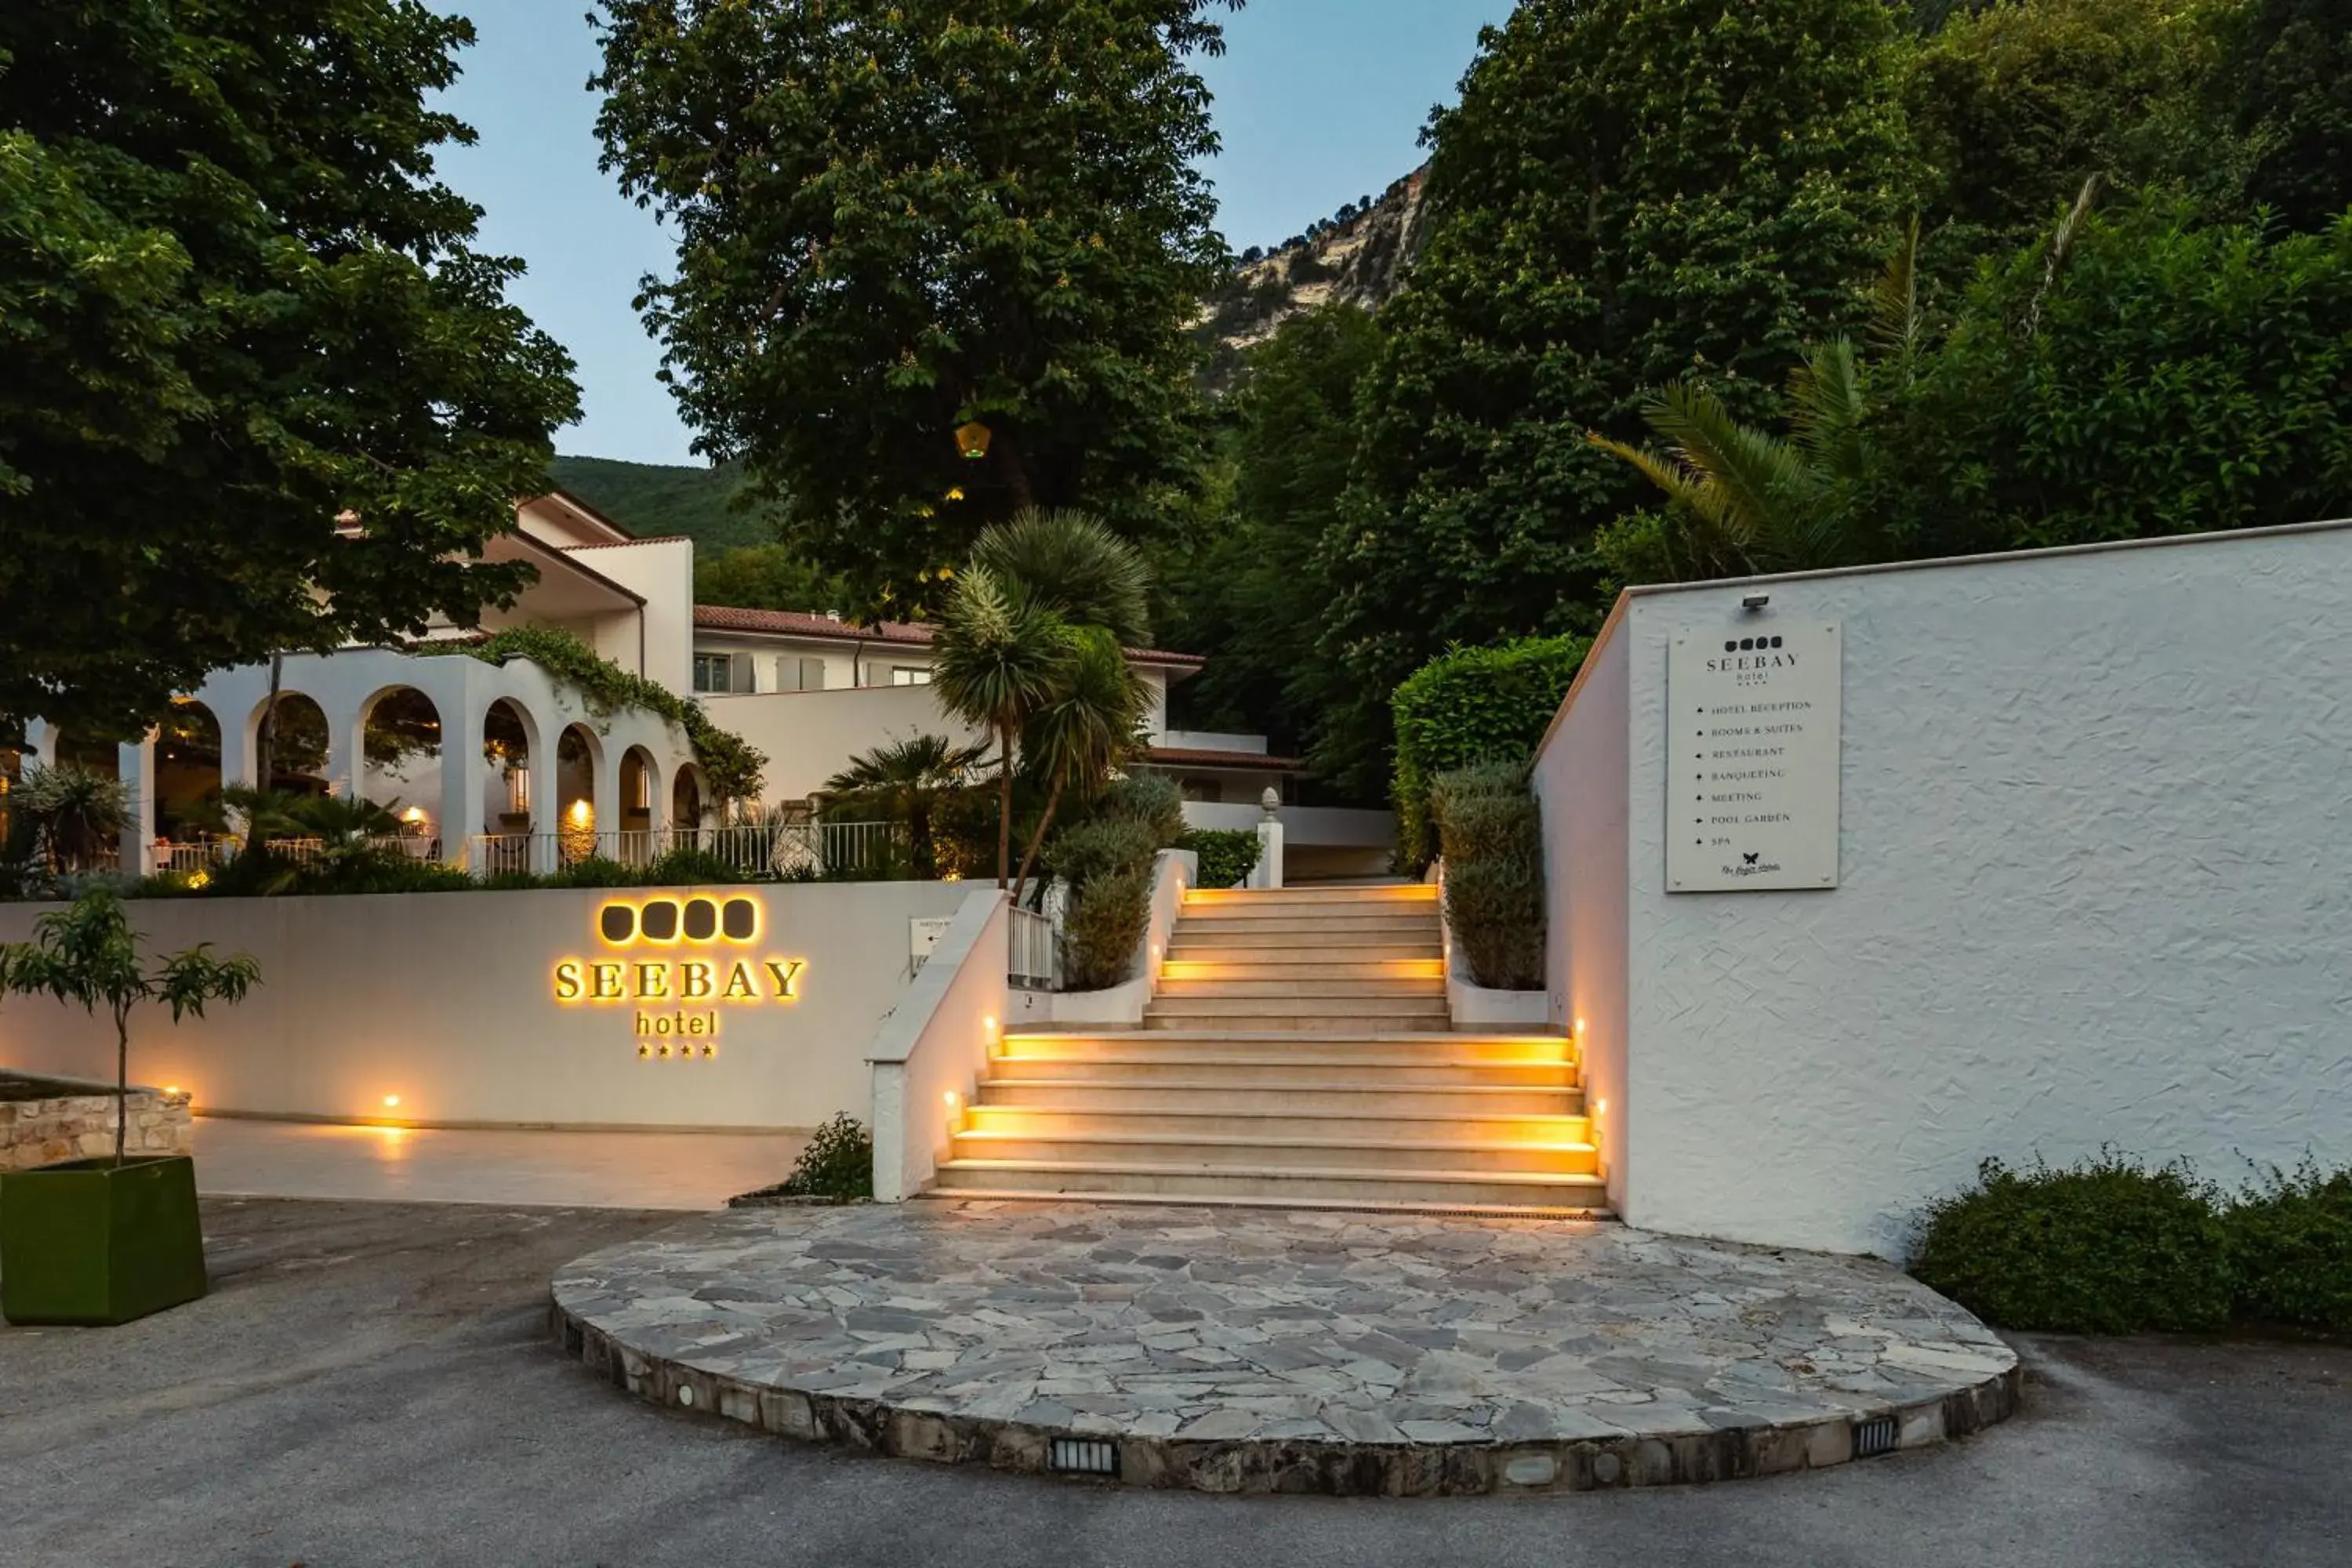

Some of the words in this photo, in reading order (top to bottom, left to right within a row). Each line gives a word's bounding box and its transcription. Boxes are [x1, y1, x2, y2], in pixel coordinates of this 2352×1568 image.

[1707, 653, 1798, 672] SEEBAY
[1737, 671, 1769, 681] hotel
[1711, 705, 1745, 714] HOTEL
[1751, 702, 1811, 713] RECEPTION
[1711, 727, 1750, 737] ROOMS
[1765, 724, 1803, 734] SUITES
[1711, 747, 1785, 759] RESTAURANT
[1711, 769, 1785, 782] BANQUETING
[1711, 792, 1762, 802] MEETING
[1744, 814, 1790, 822] GARDEN
[556, 961, 803, 998] SEEBAY
[636, 1011, 715, 1034] hotel
